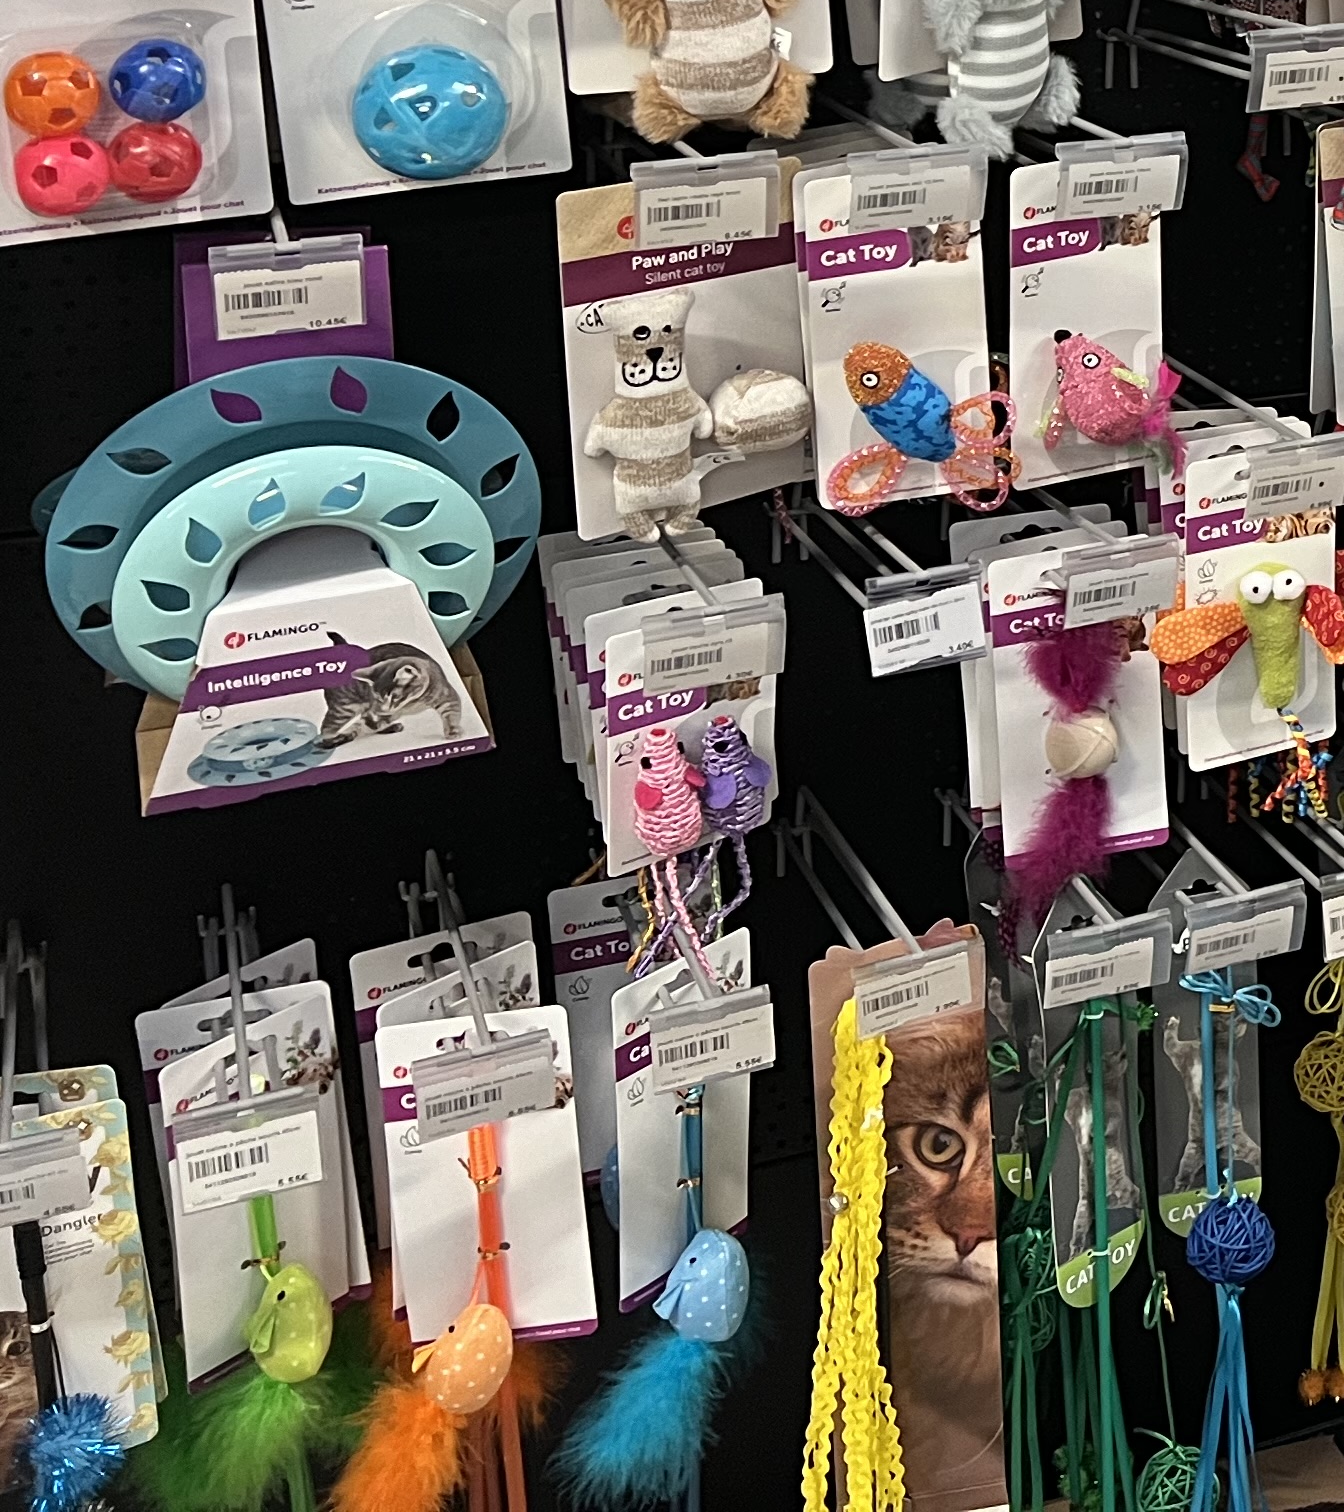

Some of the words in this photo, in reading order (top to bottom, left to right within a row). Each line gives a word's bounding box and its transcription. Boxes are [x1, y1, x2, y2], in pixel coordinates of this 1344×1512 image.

[1022, 233, 1052, 253] Cat
[1056, 228, 1088, 251] Toy
[632, 253, 666, 270] Paw
[669, 246, 696, 266] and
[700, 240, 734, 260] Play
[820, 247, 856, 268] Cat
[859, 243, 896, 268] Toy
[645, 270, 674, 285] Silent
[678, 266, 698, 281] cat
[702, 260, 725, 278] toy
[309, 317, 347, 327] 10.45€
[1198, 521, 1231, 542] Cat
[1232, 516, 1263, 538] Toy
[247, 622, 319, 643] FLAMINGO
[1010, 615, 1039, 633] Cat
[207, 666, 312, 694] Intelligence
[315, 659, 347, 675] Toy
[617, 700, 654, 722] Cat
[656, 690, 693, 714] Toy
